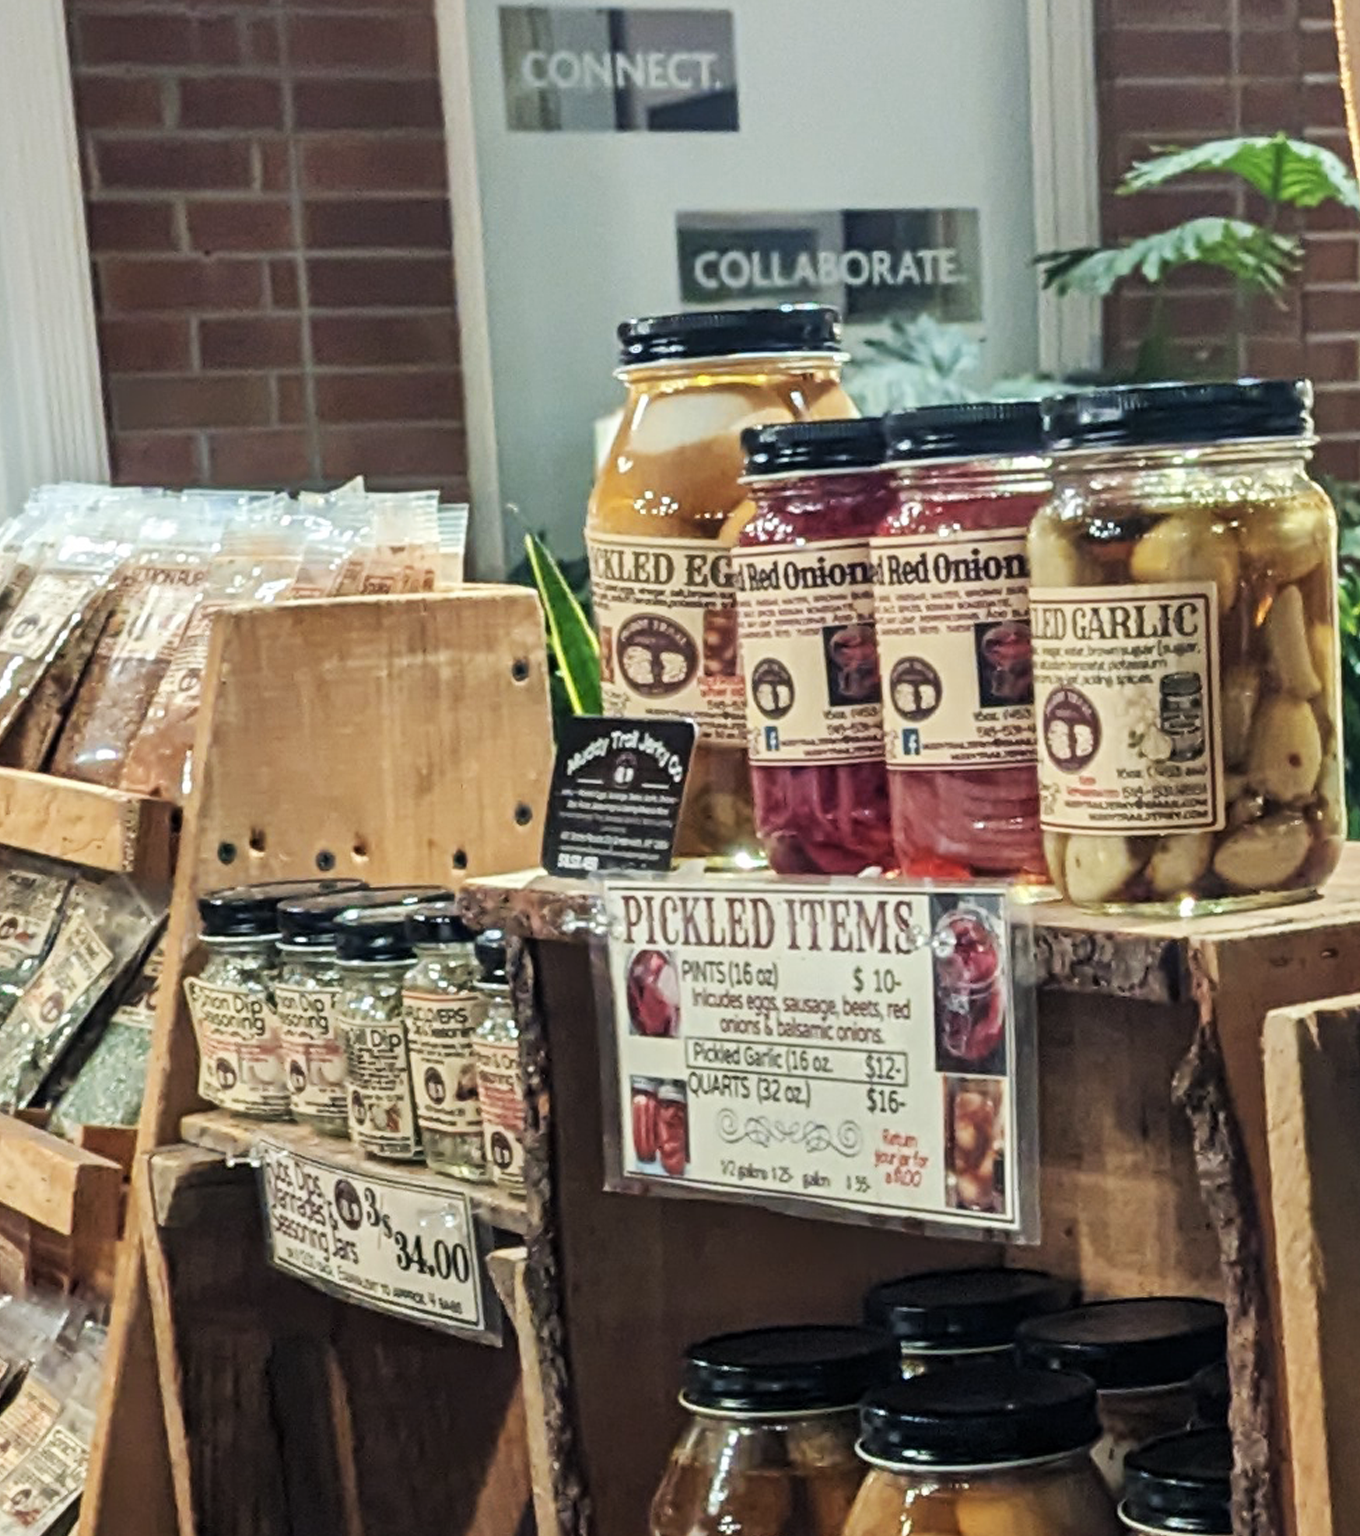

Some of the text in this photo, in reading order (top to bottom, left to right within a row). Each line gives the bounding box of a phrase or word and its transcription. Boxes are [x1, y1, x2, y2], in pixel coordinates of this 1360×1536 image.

[521, 49, 723, 91] CONNECT.
[592, 547, 676, 587] CKLED
[749, 556, 872, 592] Red Onion
[888, 548, 1031, 586] Red Onion
[1072, 602, 1198, 641] GARLIC
[610, 729, 640, 750] Trail
[621, 893, 917, 956] PICKLED ITEMS
[682, 960, 725, 984] PINTS
[728, 962, 752, 988] (16
[755, 963, 780, 991] oz)
[234, 992, 264, 1021] Dip
[782, 994, 839, 1021] sausage,
[842, 996, 885, 1021] beets,
[887, 998, 911, 1021] red
[370, 1029, 403, 1051] Dip
[720, 1014, 761, 1036] onions
[776, 1016, 834, 1040] balsamic
[692, 1041, 741, 1067] Pickled
[743, 1045, 783, 1070] Garlic
[785, 1048, 809, 1074] (16
[689, 1071, 751, 1099] QUARTS
[755, 1076, 781, 1104] (32
